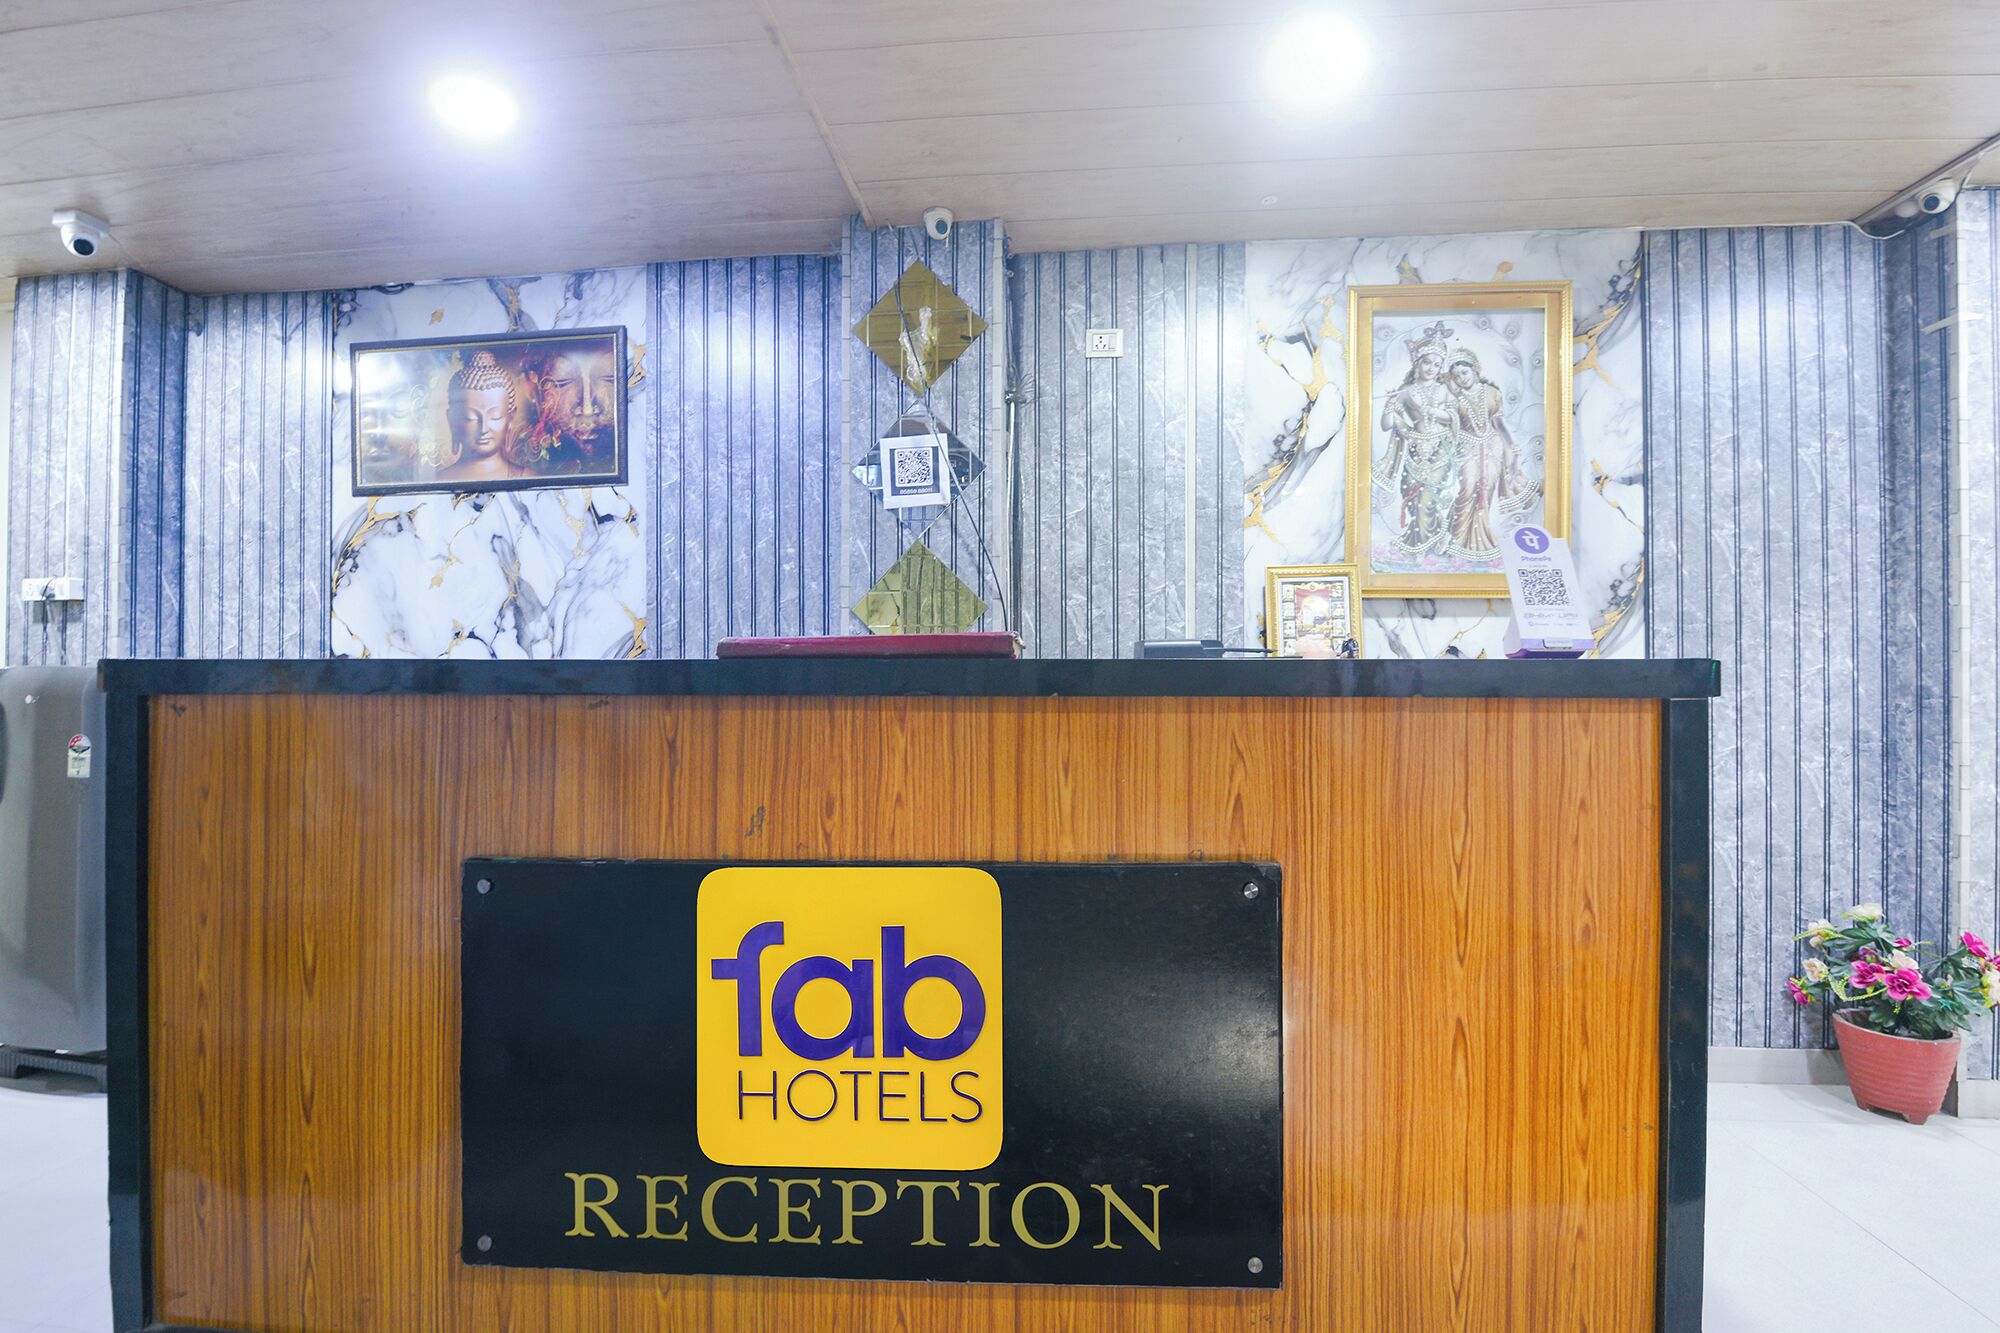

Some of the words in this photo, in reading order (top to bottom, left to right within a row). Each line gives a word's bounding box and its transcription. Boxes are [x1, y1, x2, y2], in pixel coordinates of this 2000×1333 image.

[711, 921, 986, 1061] fab
[738, 1069, 983, 1123] HOTELS
[564, 1172, 1170, 1251] RECEPTION
